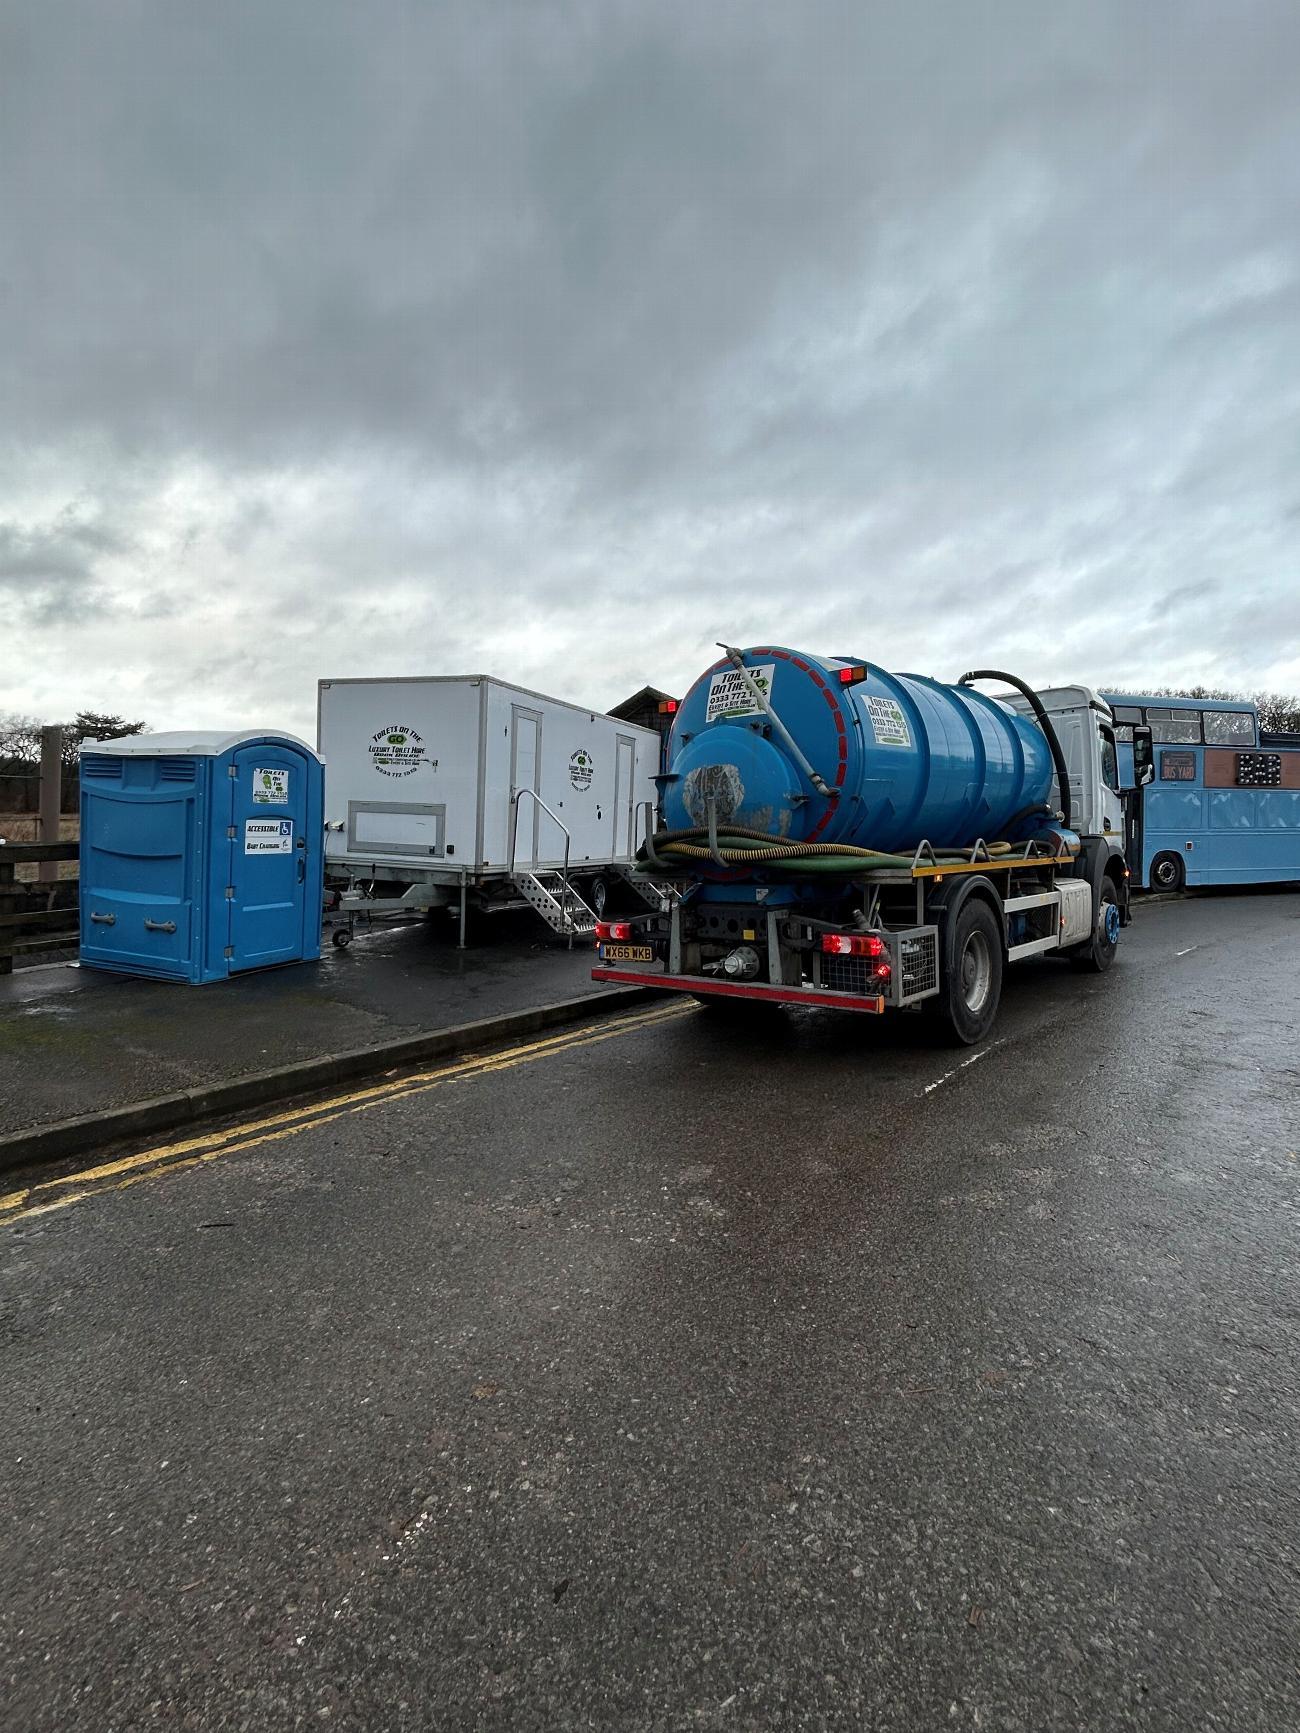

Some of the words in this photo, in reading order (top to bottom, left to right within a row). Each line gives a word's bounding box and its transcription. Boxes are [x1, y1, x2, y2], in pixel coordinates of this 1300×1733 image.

[722, 669, 763, 683] TOILTS
[710, 695, 729, 704] 0333
[731, 692, 747, 700] 772
[749, 688, 768, 697] 15
[372, 725, 398, 742] TOILETS
[410, 730, 423, 743] THE
[389, 735, 405, 743] GO
[1239, 755, 1281, 784] BAR
